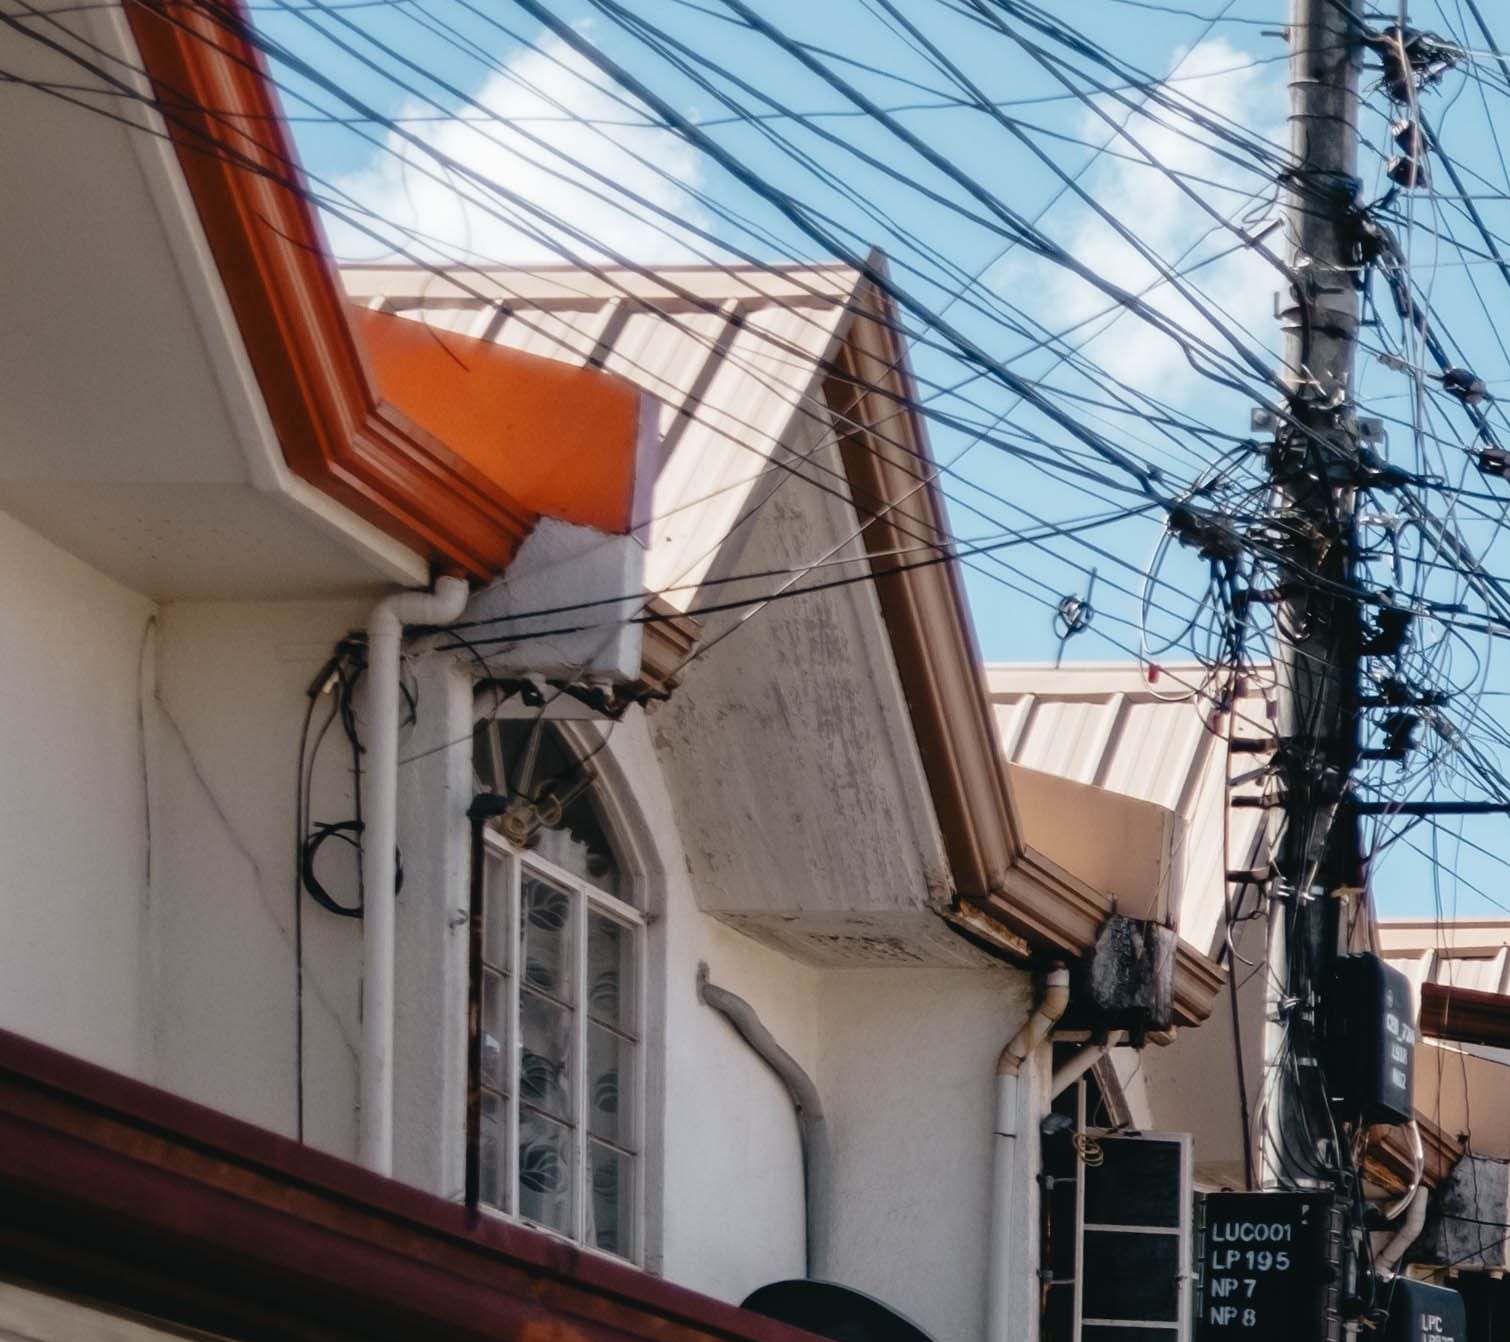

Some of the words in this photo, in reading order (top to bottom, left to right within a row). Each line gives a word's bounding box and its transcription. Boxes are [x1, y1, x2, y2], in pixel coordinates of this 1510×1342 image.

[1212, 1249, 1241, 1270] LP
[1246, 1250, 1291, 1271] 195
[1211, 1278, 1239, 1298] NP
[1243, 1278, 1257, 1298] 7
[1210, 1306, 1238, 1326] NP
[1242, 1308, 1257, 1327] 8
